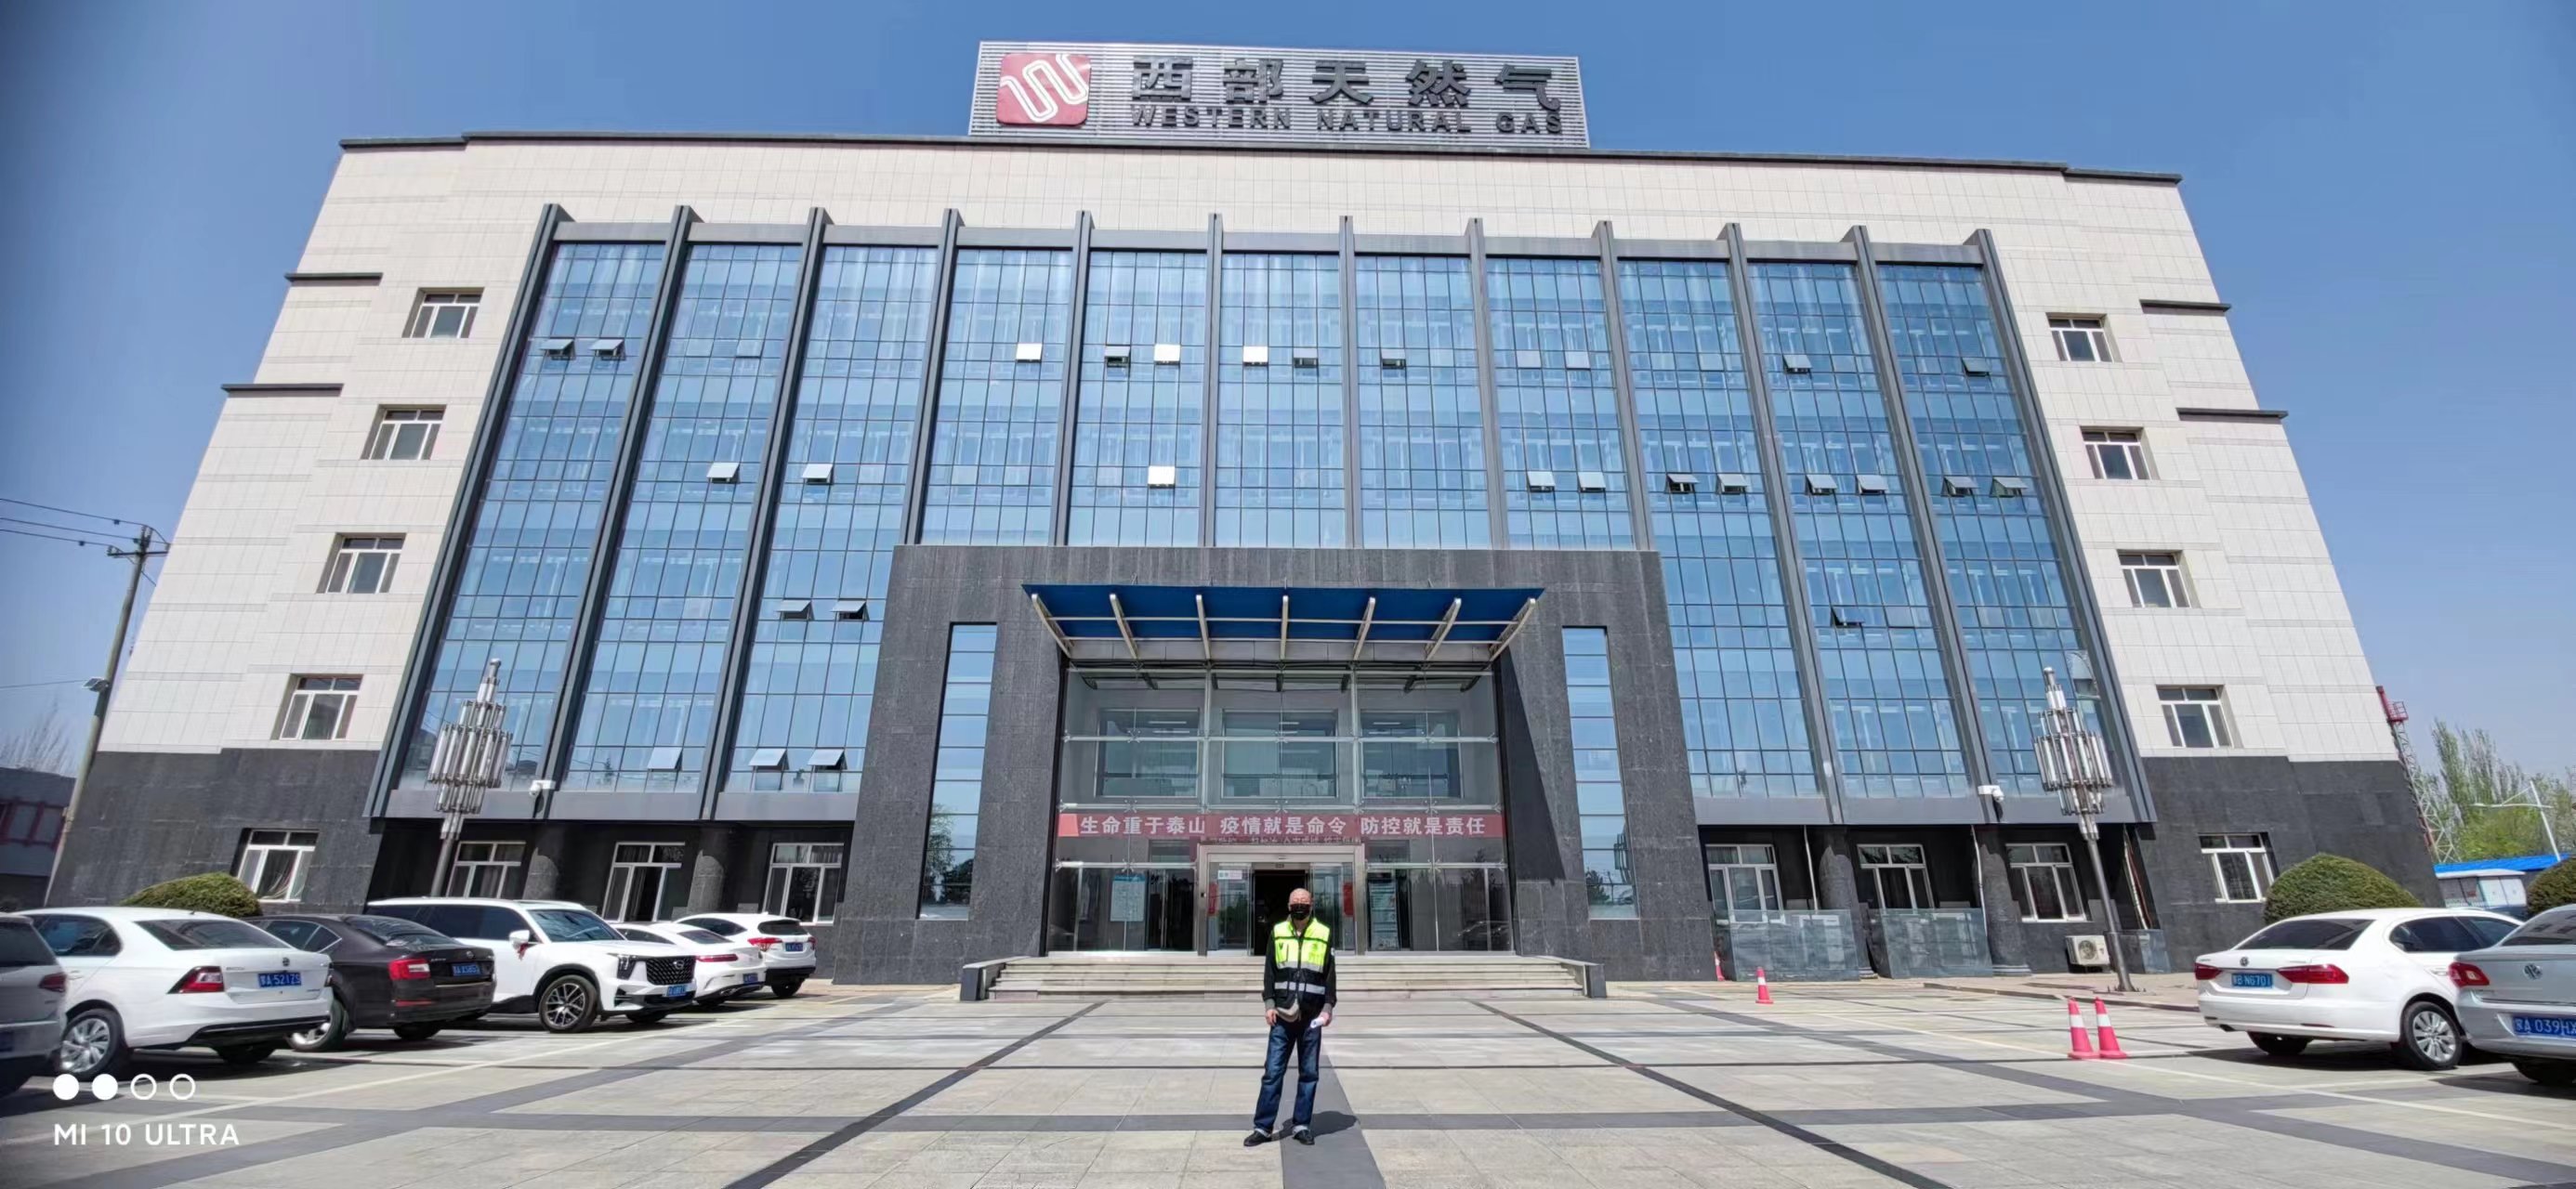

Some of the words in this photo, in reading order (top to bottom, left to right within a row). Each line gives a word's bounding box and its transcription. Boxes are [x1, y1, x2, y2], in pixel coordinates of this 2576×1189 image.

[1132, 56, 1561, 111] 西部天然气
[1131, 104, 1290, 129] WESTERN
[1317, 109, 1471, 132] NATURAL
[1495, 111, 1562, 134] GAS
[1080, 816, 1205, 835] 生命重于泰山
[1220, 817, 1347, 835] 疫情就是命令
[1360, 817, 1486, 835] 防控就是责任
